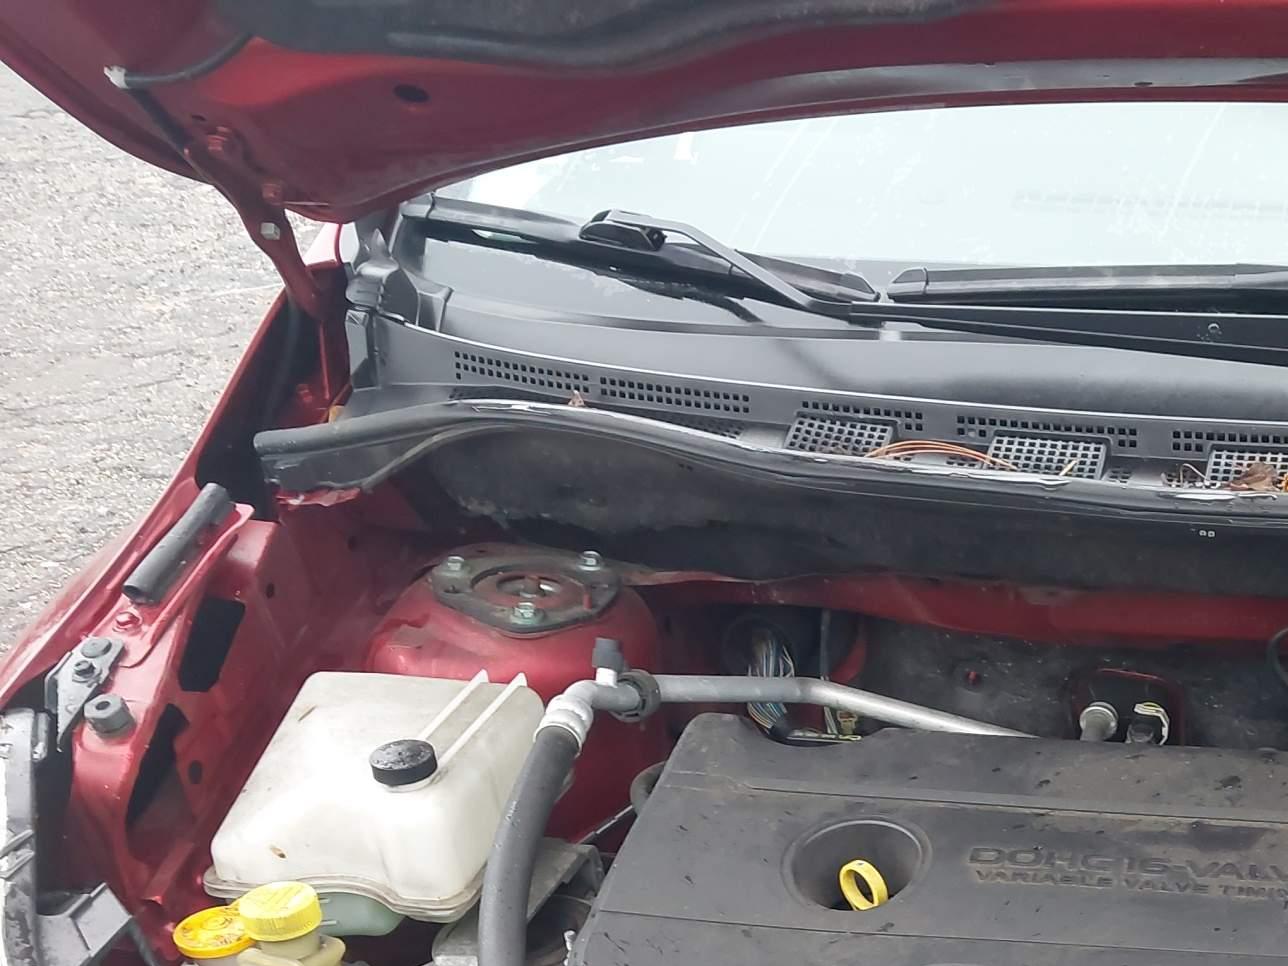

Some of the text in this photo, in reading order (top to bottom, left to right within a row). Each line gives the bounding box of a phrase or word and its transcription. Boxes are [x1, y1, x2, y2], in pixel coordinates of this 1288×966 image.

[968, 847, 1117, 872] DOHC
[975, 868, 1113, 889] VARIABLE
[1123, 876, 1210, 895] VALVE
